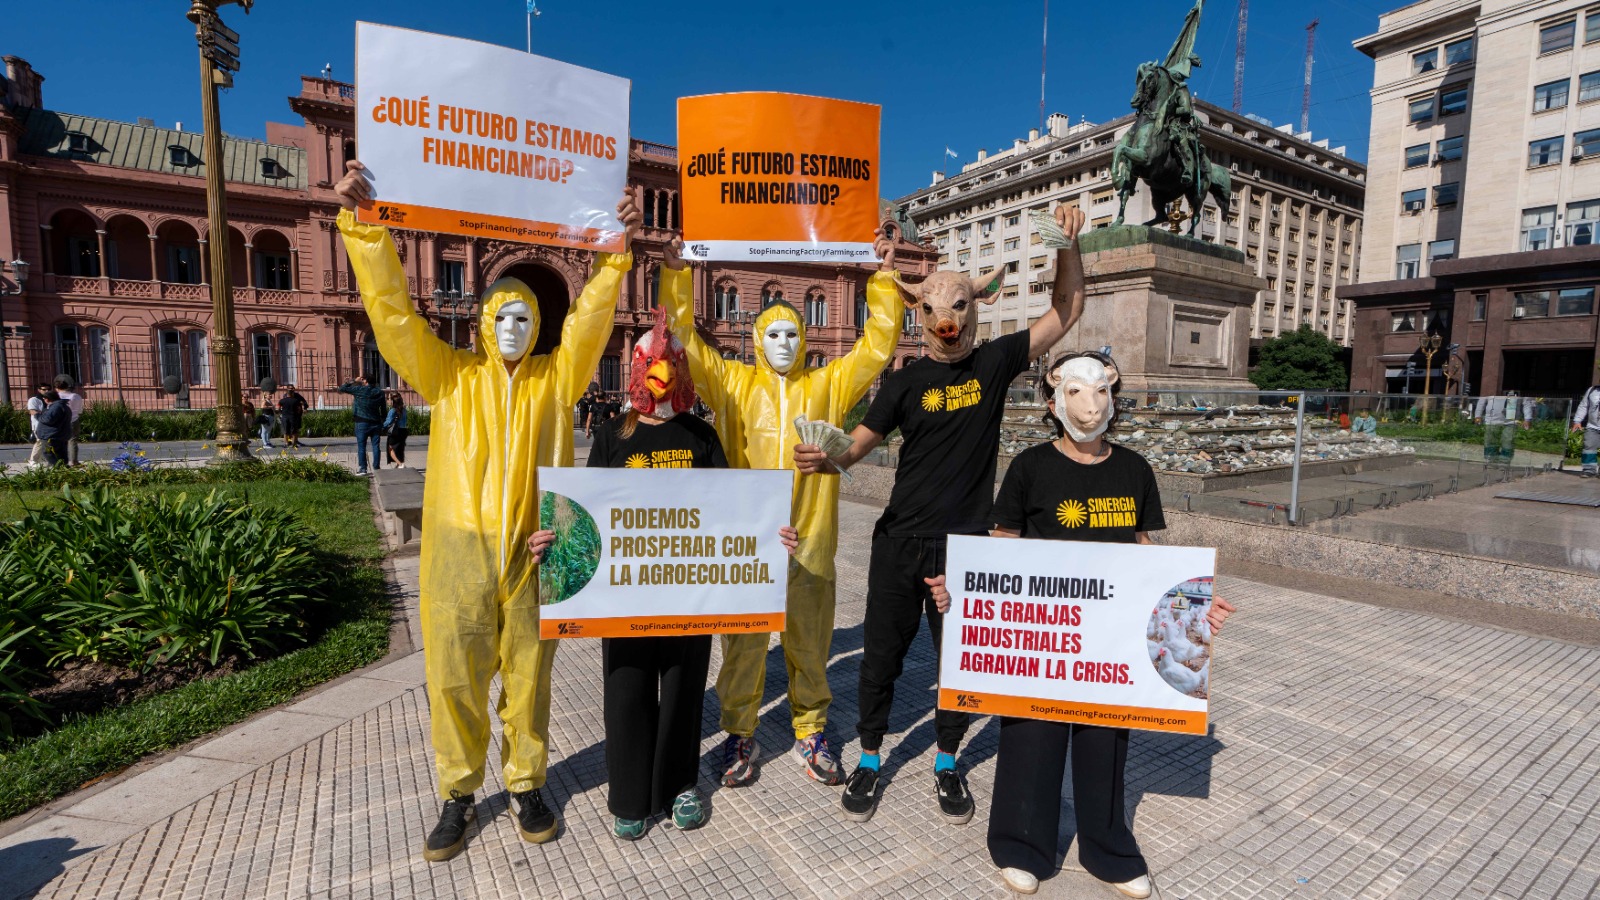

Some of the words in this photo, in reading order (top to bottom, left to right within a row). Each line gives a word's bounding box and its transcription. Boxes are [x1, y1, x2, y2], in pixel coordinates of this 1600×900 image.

[372, 95, 430, 128] ¿QUÉ
[438, 104, 518, 142] FUTURO
[525, 119, 617, 161] ESTAMOS
[423, 136, 575, 184] FINANCIANDO?
[687, 147, 726, 178] ¿QUÉ
[732, 152, 794, 175] FUTURO
[800, 153, 871, 181] ESTAMOS
[721, 181, 840, 206] FINANCIANDO?
[749, 247, 870, 257] StopFinancingFactoryFarming.com
[651, 449, 694, 463] SINERGIA
[1087, 496, 1137, 513] SINERGIA
[610, 508, 701, 530] PODEMOS
[610, 536, 717, 558] PROSPERAR
[722, 536, 757, 557] CON
[609, 564, 632, 586] LA
[638, 558, 775, 586] AGROECOLOGÍA.
[964, 571, 1023, 596] BANCO
[1028, 575, 1115, 601] MUNDIAL:
[963, 597, 995, 621] LAS
[1000, 601, 1082, 627] GRANJAS
[630, 620, 769, 631] StopFinancingFactoryFarming.com
[961, 625, 1082, 654] INDUSTRIALES
[960, 651, 1040, 679] AGRAVAN
[1045, 658, 1067, 680] LA
[1072, 661, 1135, 686] CRISIS.
[1030, 704, 1187, 726] StopFinancingFactoryFarming.com
